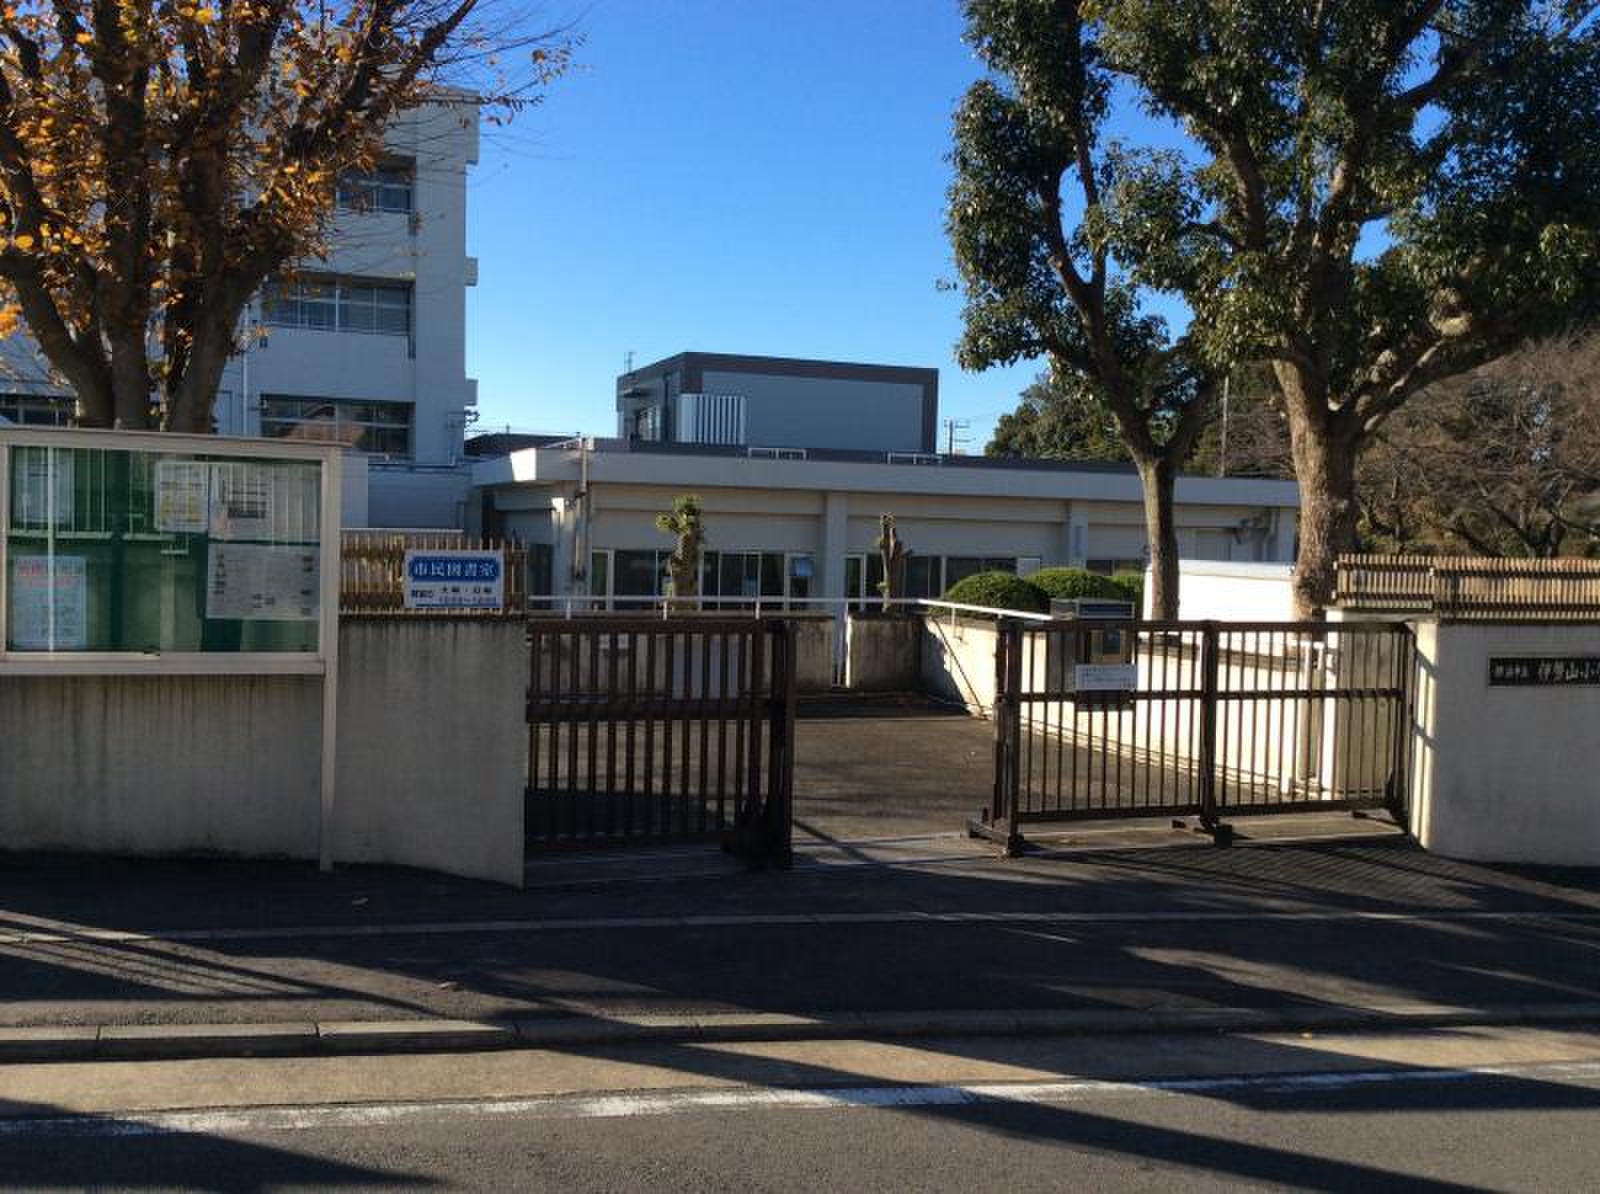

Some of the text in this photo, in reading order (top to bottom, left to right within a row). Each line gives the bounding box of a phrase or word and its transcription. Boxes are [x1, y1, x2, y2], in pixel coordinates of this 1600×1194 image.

[414, 560, 494, 577] 市民図書室
